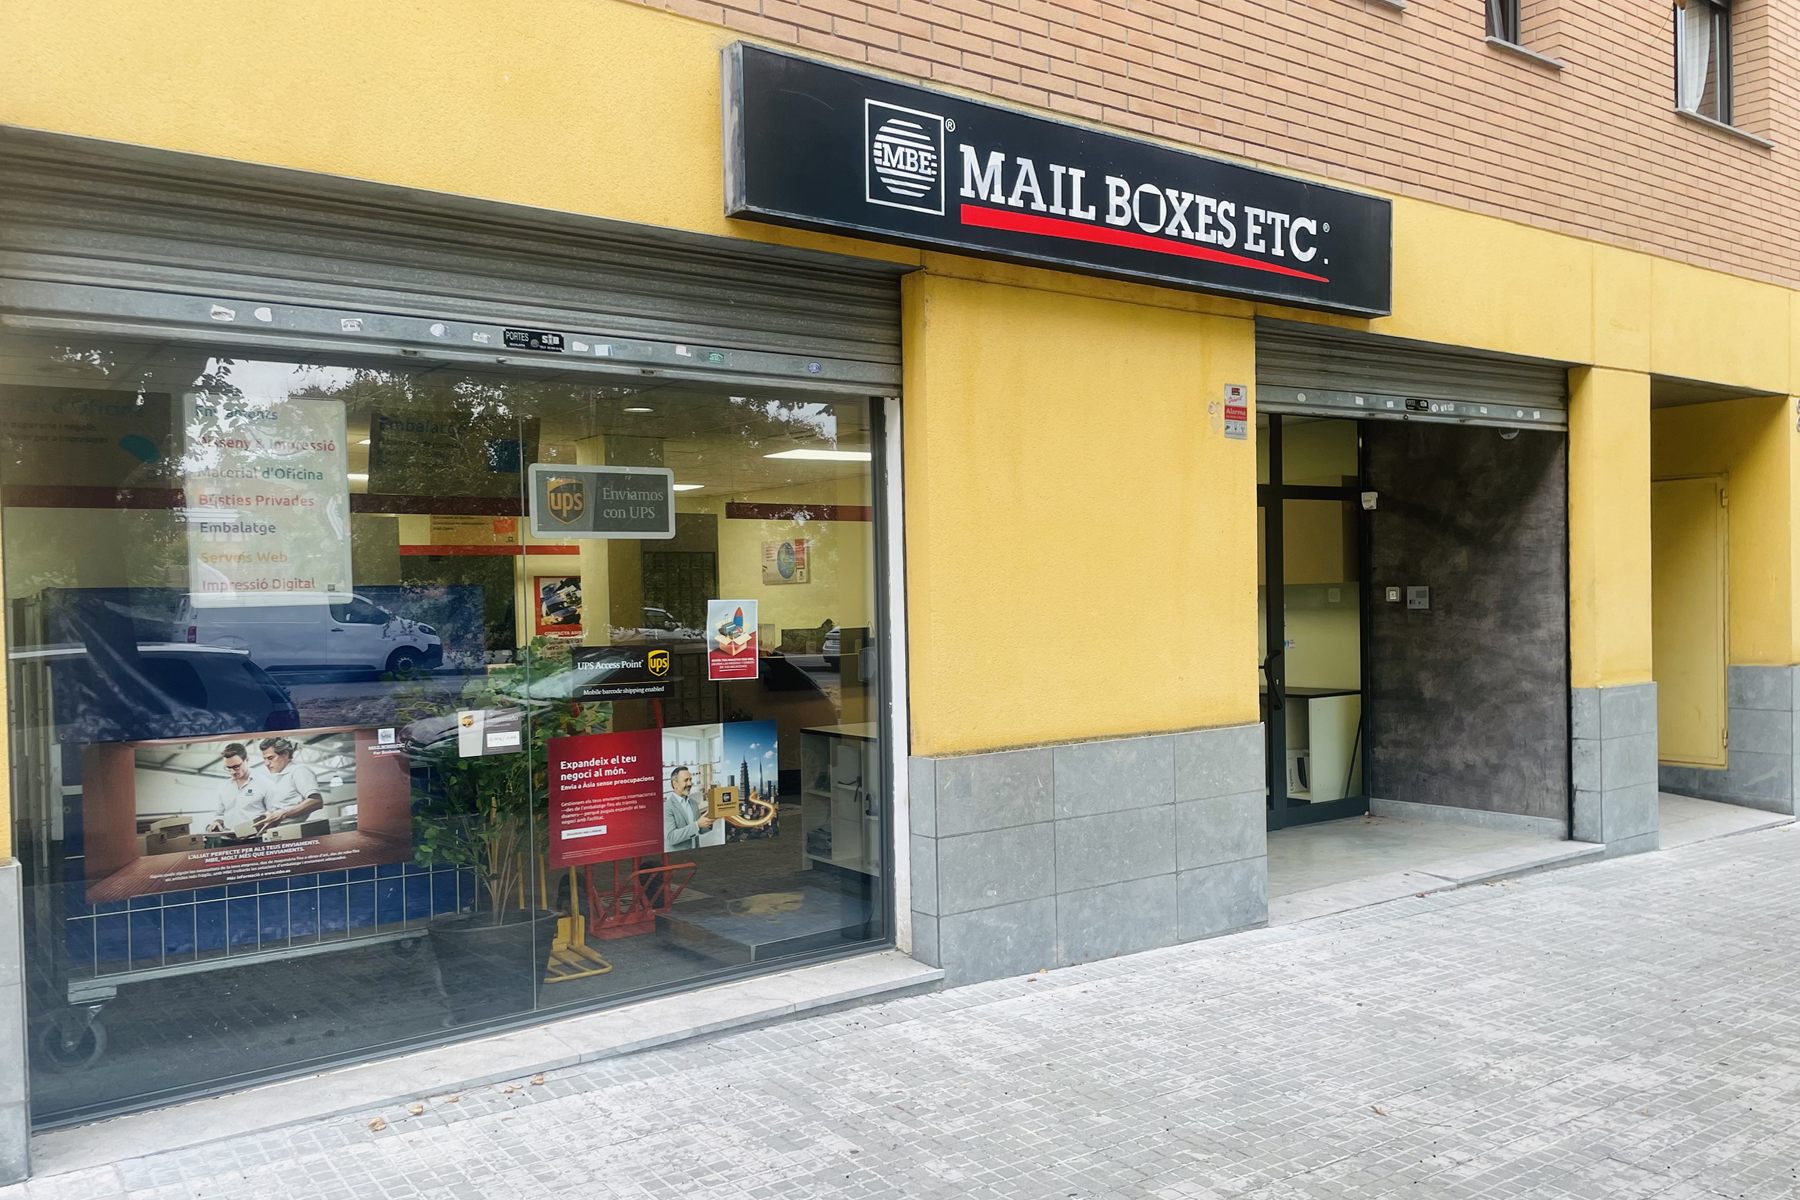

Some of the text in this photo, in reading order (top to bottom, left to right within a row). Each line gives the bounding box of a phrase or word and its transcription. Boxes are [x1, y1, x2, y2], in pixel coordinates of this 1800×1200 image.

[882, 143, 932, 175] MBE
[959, 143, 1096, 221] MAIL
[1105, 175, 1237, 249] BOXES
[505, 331, 530, 342] PORTES
[261, 467, 323, 481] d'Oficina
[255, 494, 315, 507] Privades
[602, 487, 664, 501] Enviamos
[550, 492, 583, 518] ups
[603, 506, 656, 519] con UPS
[200, 522, 277, 536] Embalatge
[256, 551, 288, 563] Web
[203, 577, 316, 593] Impressió Digital
[577, 661, 595, 671] UPS
[595, 661, 621, 670] Access
[650, 657, 669, 672] ups
[623, 687, 645, 695] shipping
[560, 755, 637, 770] Expandeix el teu
[560, 766, 627, 782] negoci al món.
[583, 781, 595, 789] Àsia
[614, 776, 655, 786] preocupacions
[187, 852, 210, 860] L'ALIAT
[210, 849, 240, 858] PERFECTE
[241, 847, 253, 855] PER
[266, 843, 281, 851] TEUS
[281, 840, 321, 850] ENVIAMENTS.
[265, 847, 305, 856] ENVIAMENTS.
